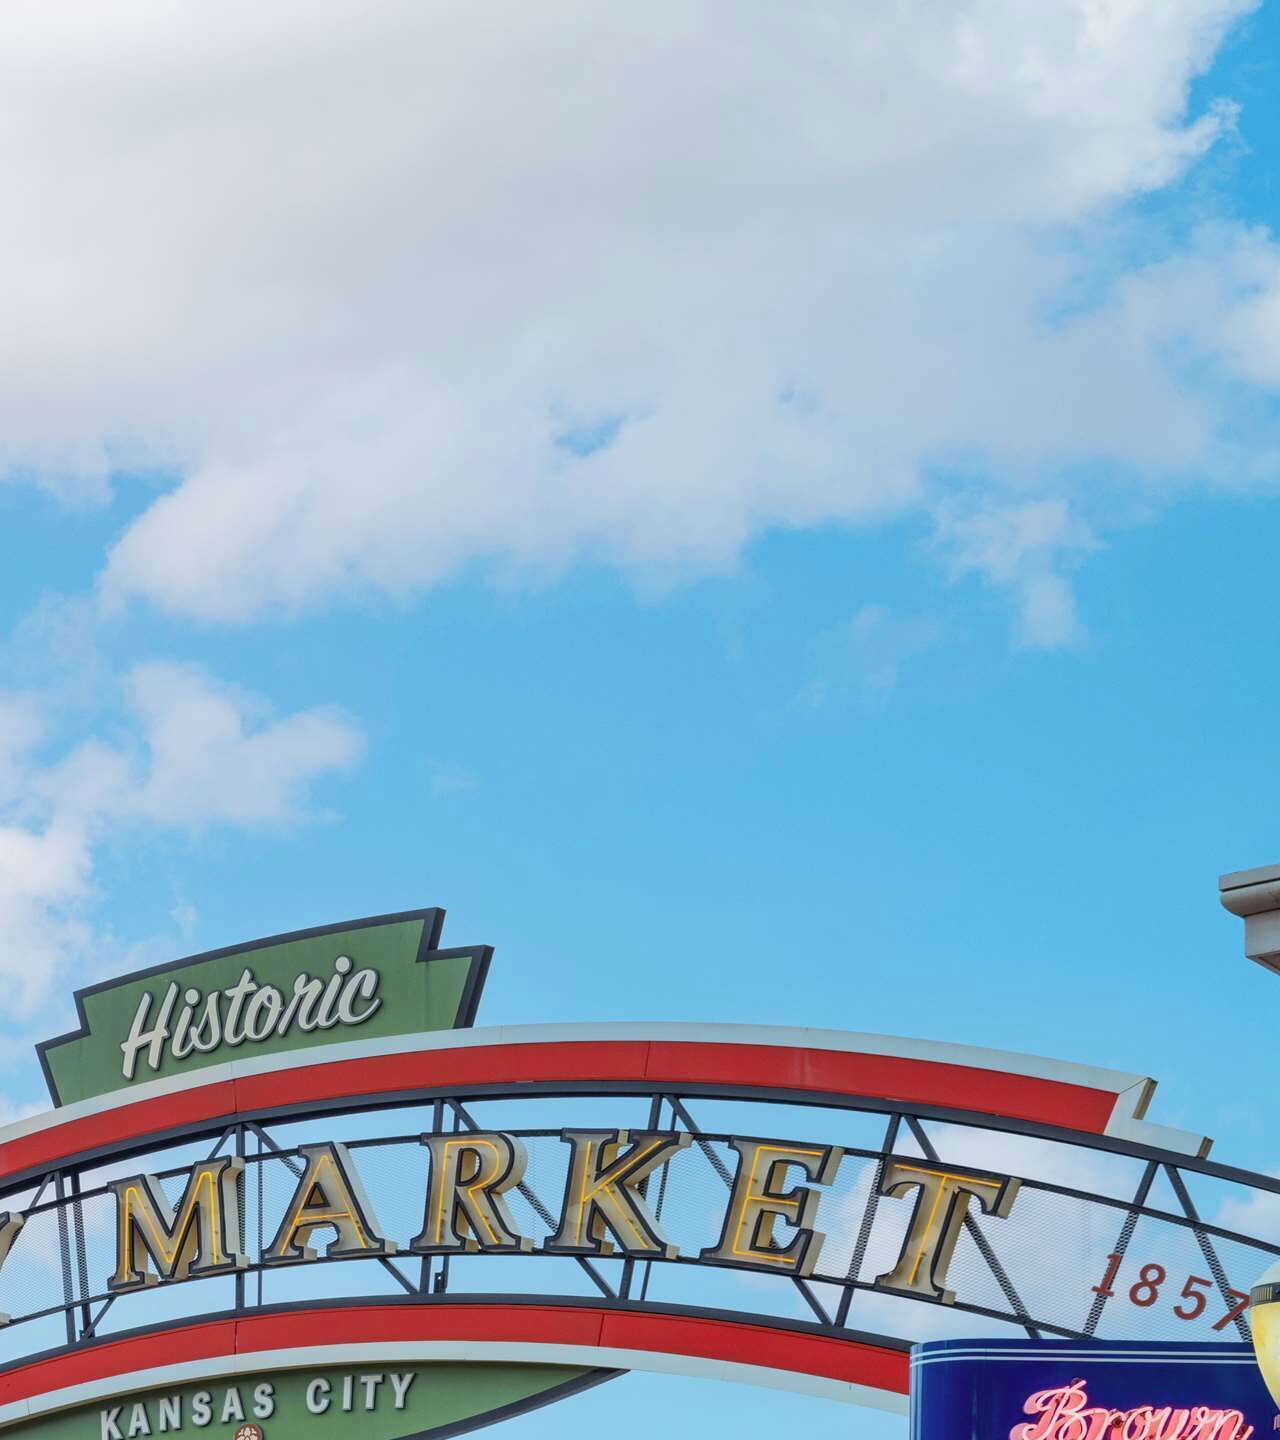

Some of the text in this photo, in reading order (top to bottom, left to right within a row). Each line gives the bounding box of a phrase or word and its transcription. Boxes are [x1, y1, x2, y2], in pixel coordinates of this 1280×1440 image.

[120, 956, 382, 1080] Historic
[107, 1127, 1022, 1304] MARKET
[1091, 1252, 1250, 1332] 1857
[305, 1371, 418, 1415] CITY
